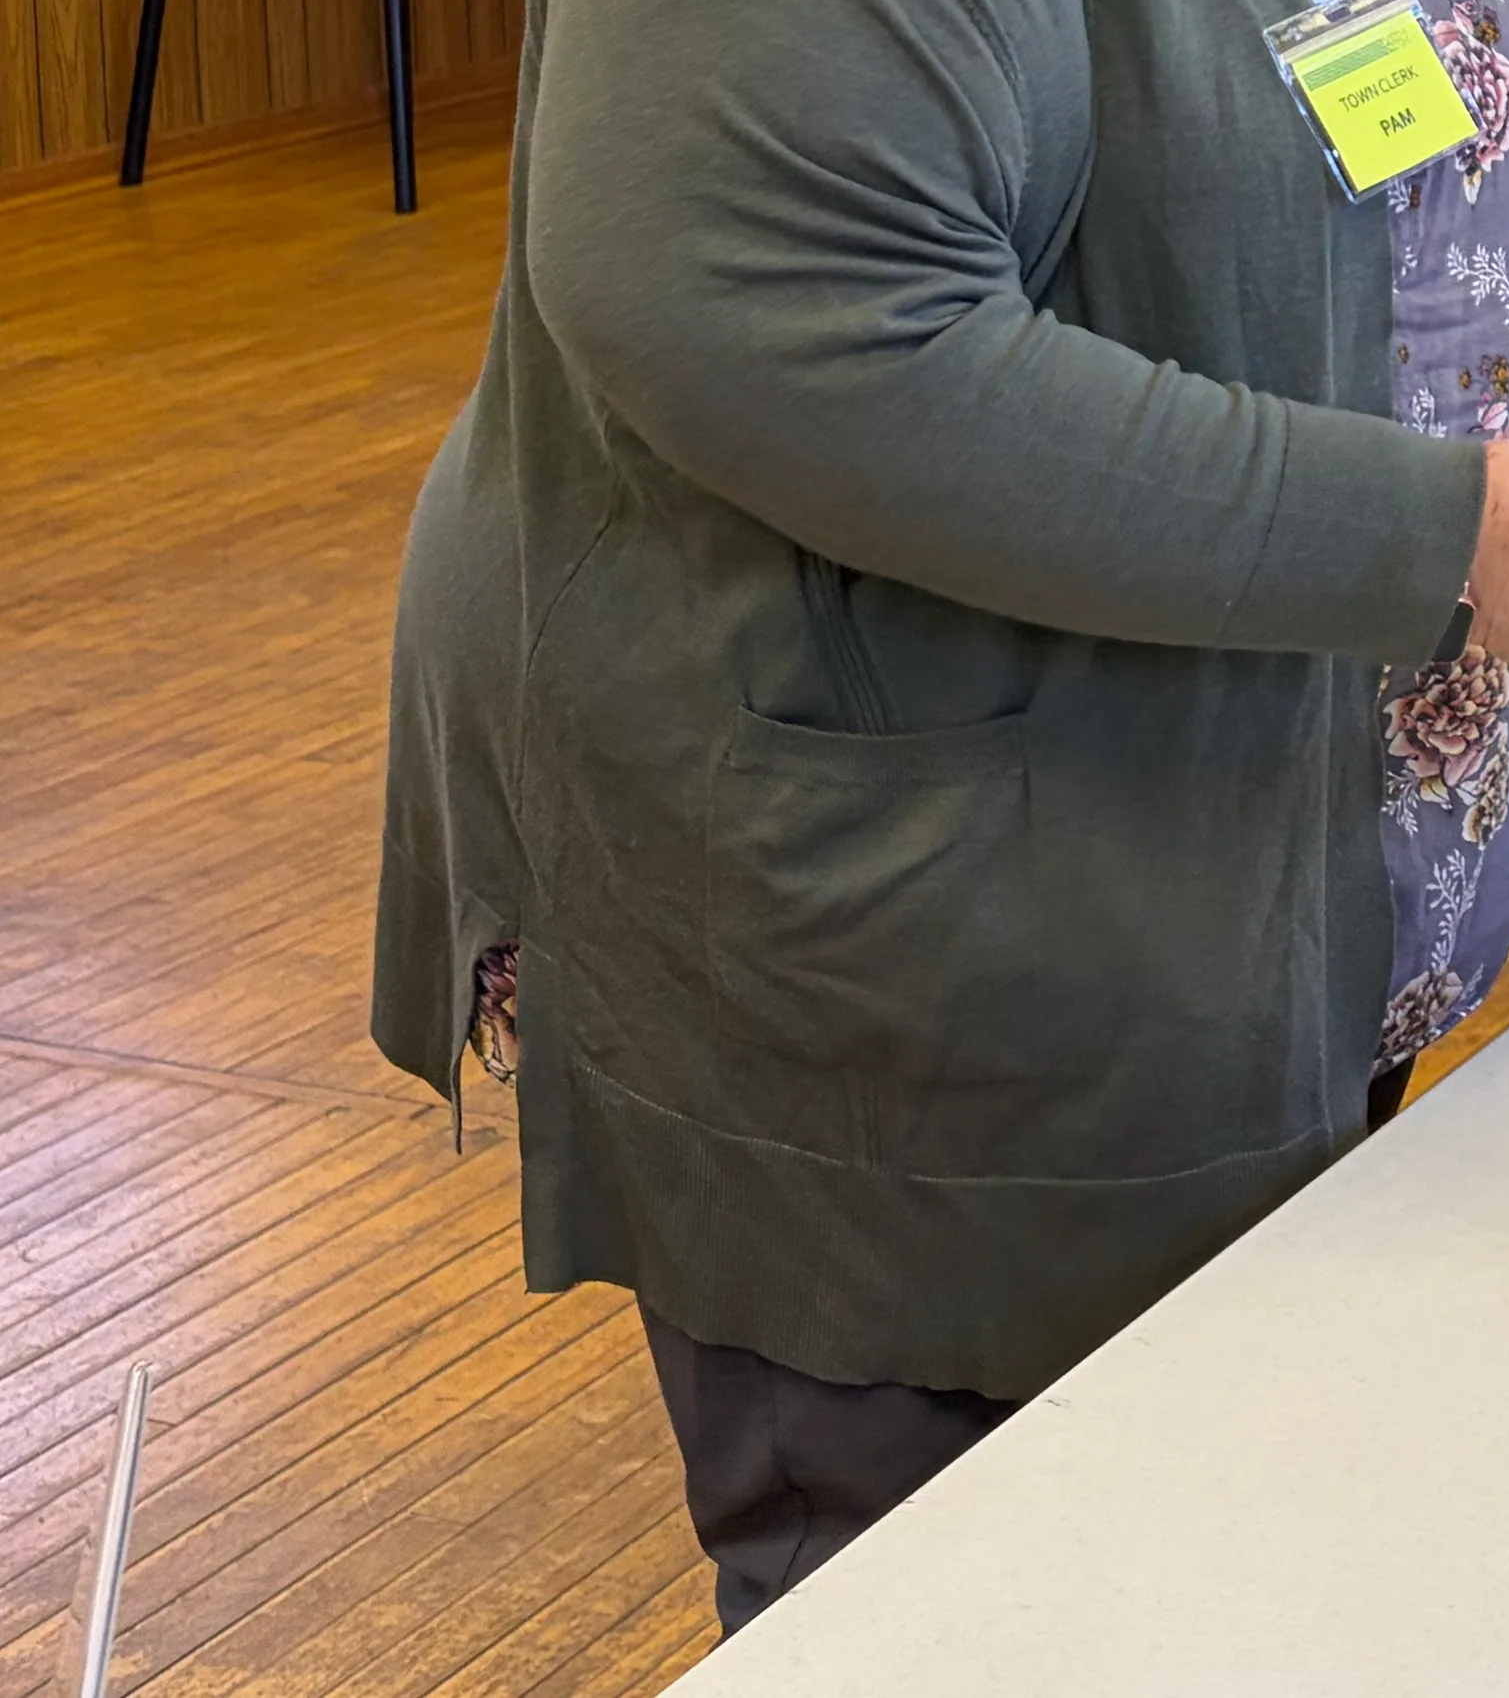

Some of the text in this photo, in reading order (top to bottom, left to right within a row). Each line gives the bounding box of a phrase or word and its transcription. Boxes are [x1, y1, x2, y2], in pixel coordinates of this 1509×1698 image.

[1339, 83, 1380, 113] TOWN
[1378, 66, 1419, 93] CLERK
[1380, 107, 1416, 137] PAM
